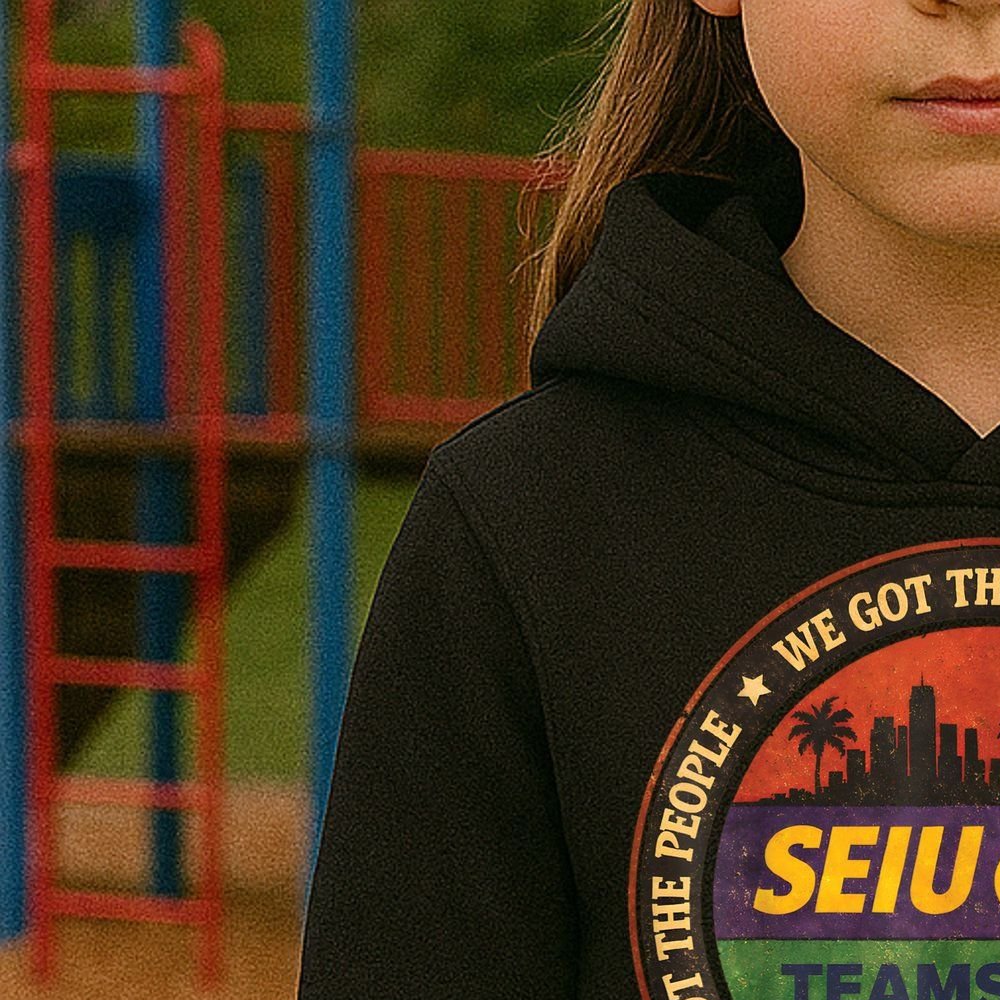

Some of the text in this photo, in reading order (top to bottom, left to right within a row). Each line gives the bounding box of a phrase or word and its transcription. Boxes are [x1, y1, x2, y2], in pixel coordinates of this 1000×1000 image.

[771, 608, 847, 672] WE
[848, 574, 932, 632] GOT
[655, 709, 742, 862] PEOPLE
[752, 824, 985, 915] SEIU
[651, 876, 694, 961] THE
